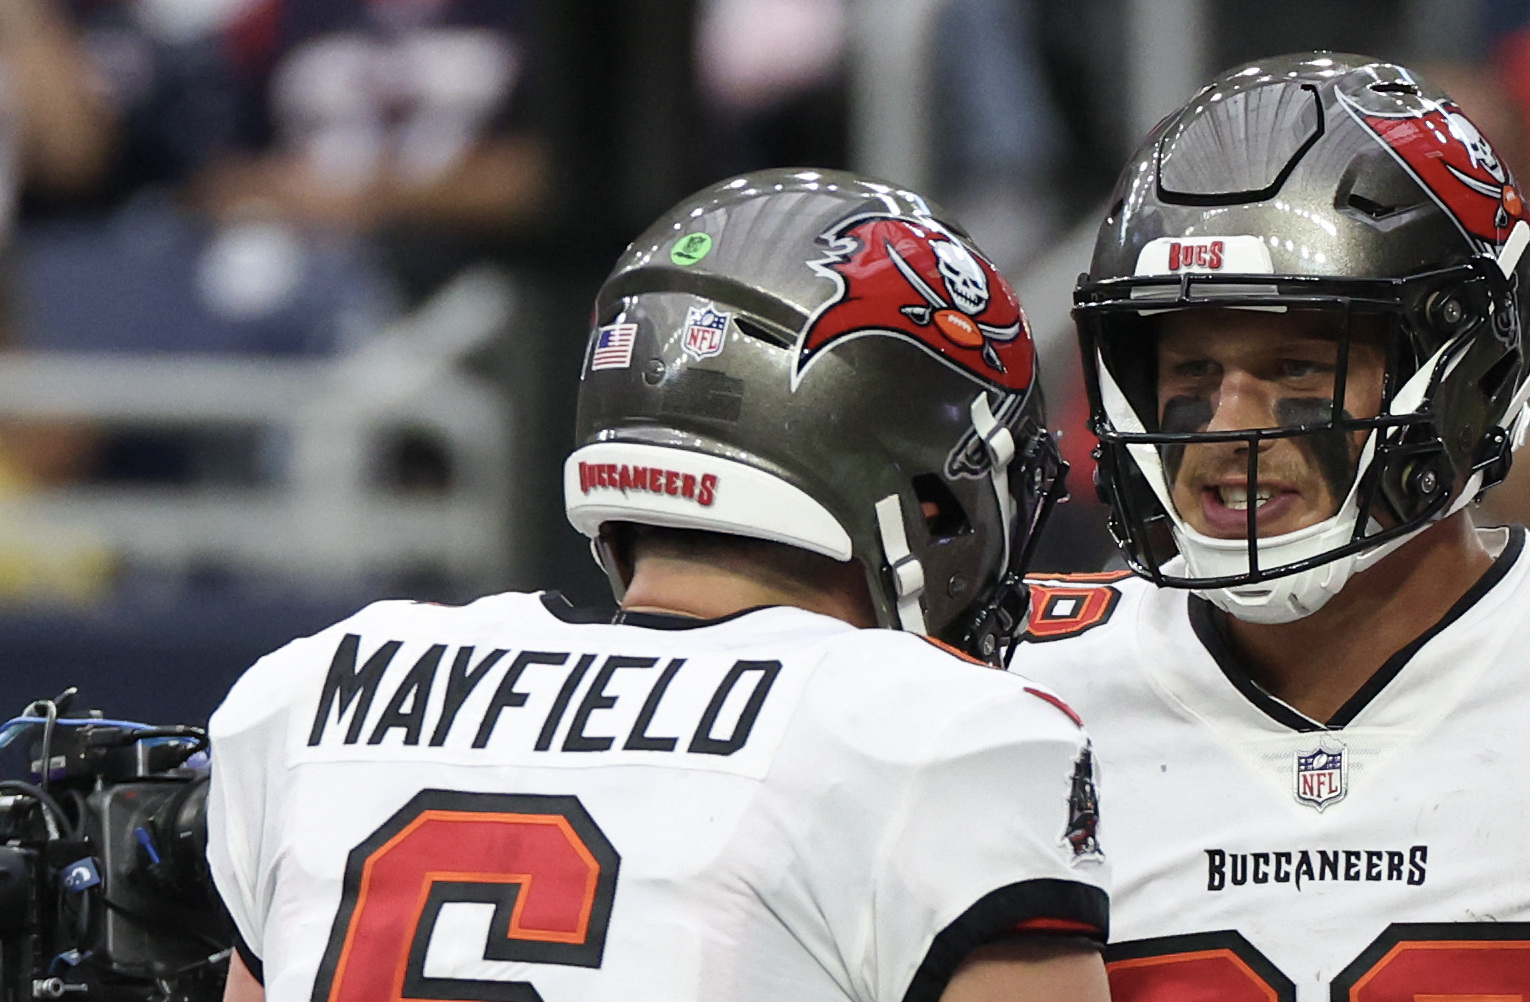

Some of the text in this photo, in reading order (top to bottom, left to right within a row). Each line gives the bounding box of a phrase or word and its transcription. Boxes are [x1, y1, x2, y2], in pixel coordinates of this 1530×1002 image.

[686, 326, 718, 351] NFL
[307, 633, 783, 757] MAYFIELD
[1301, 771, 1339, 799] NFL
[1203, 845, 1429, 893] BUCCANEERS
